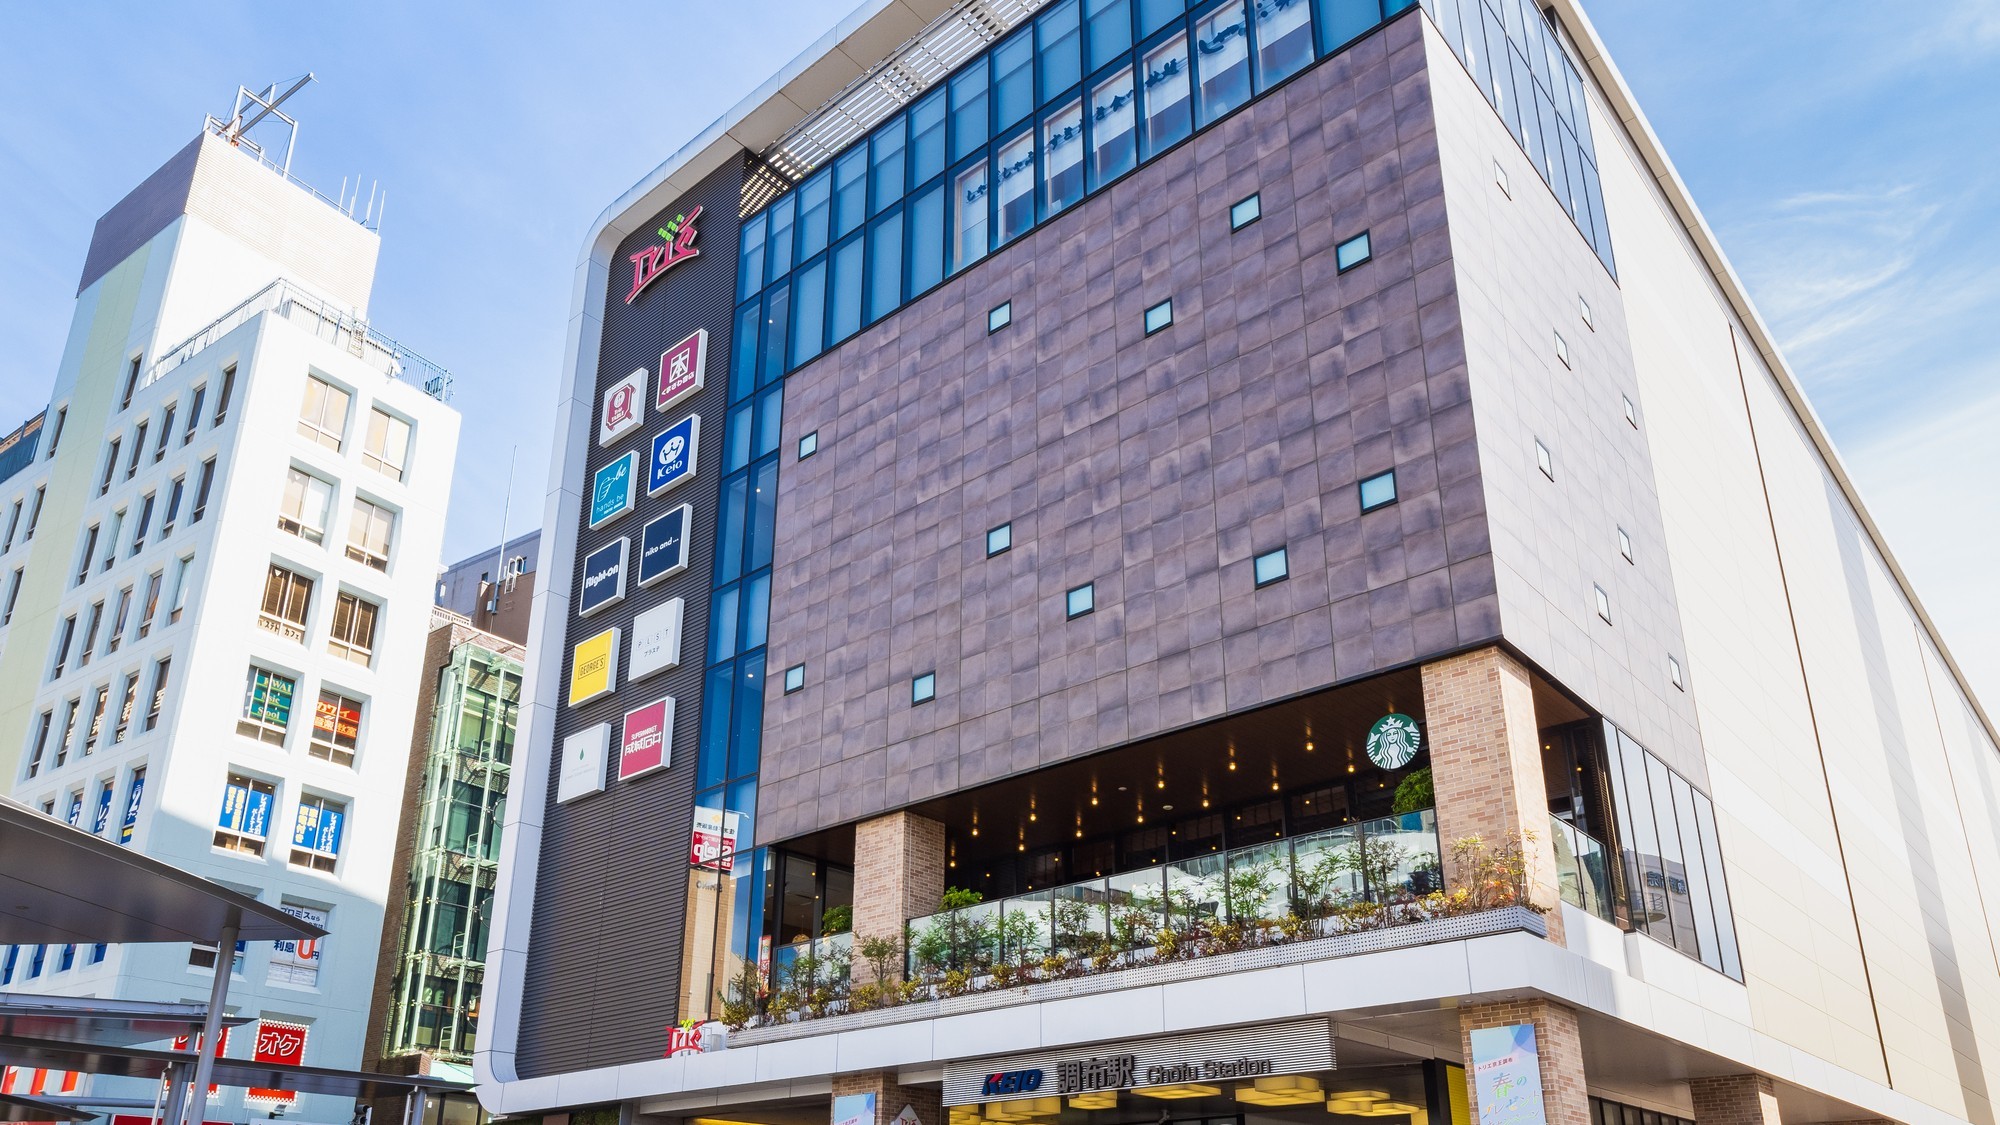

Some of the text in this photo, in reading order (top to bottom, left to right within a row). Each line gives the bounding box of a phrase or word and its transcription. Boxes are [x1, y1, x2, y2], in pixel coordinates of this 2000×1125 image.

[656, 460, 683, 480] Keio
[645, 546, 659, 558] niko
[659, 537, 673, 550] and
[585, 564, 619, 589] Right-on
[285, 627, 300, 640] カフェ
[579, 657, 605, 677] GEORGE'S
[624, 731, 662, 757] 成城石井
[631, 725, 658, 741] SUPERMARKET
[259, 1032, 301, 1057] オケ
[981, 1054, 1272, 1096] KEIO 調布駅 Chofu Station
[1477, 1057, 1513, 1072] トリエ京王調布
[1491, 1072, 1527, 1098] 春の
[1481, 1089, 1540, 1120] プレゼント
